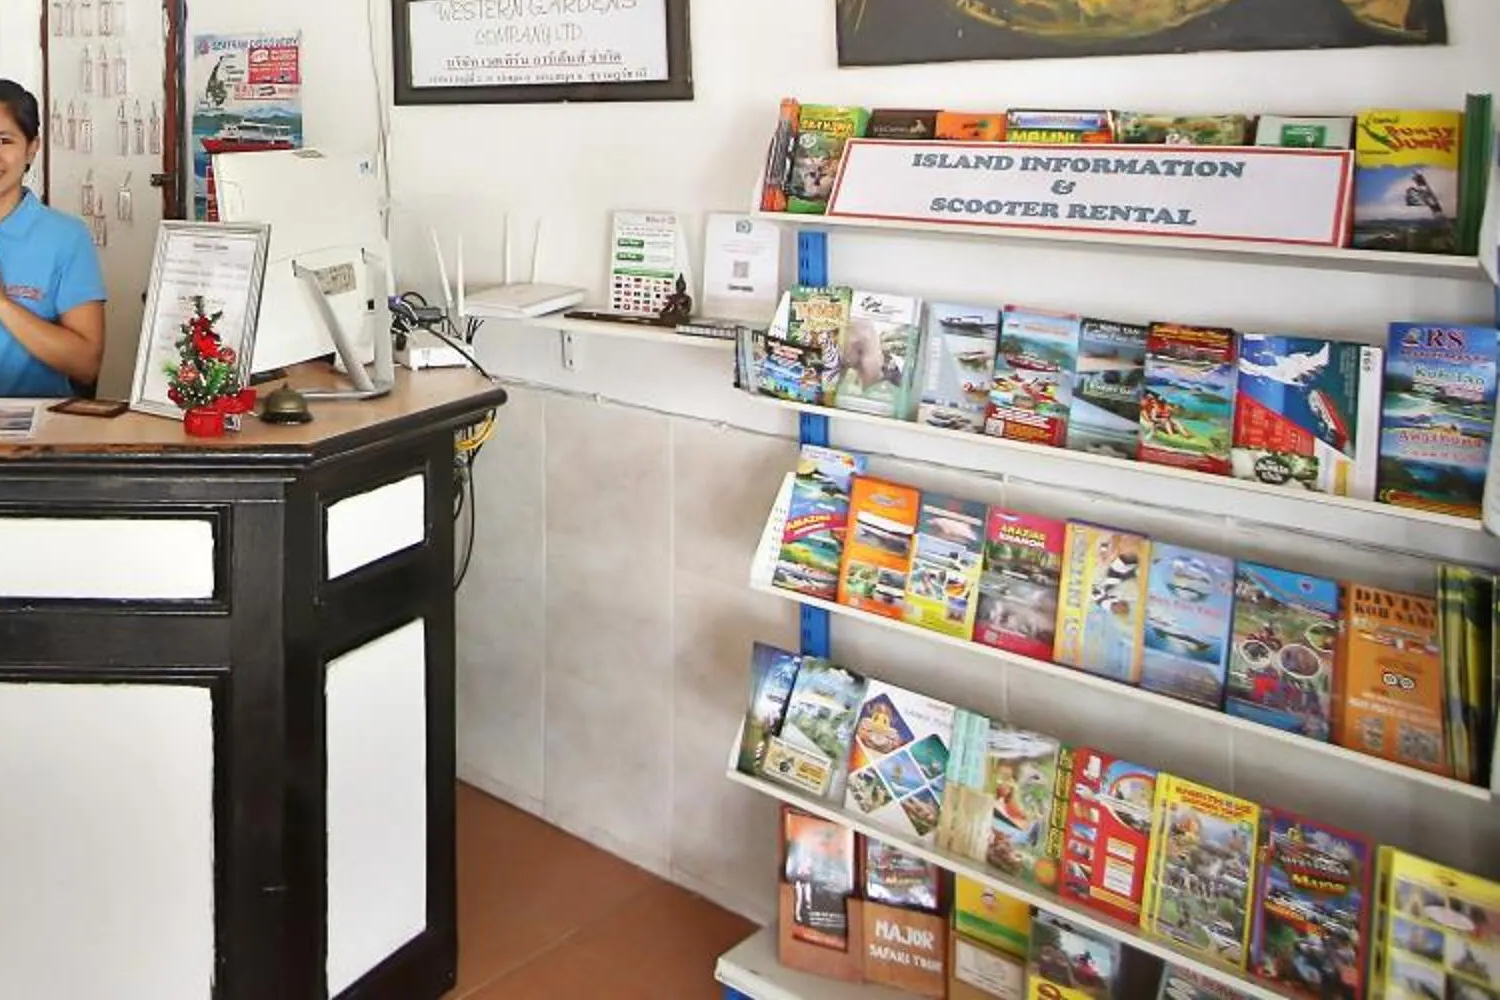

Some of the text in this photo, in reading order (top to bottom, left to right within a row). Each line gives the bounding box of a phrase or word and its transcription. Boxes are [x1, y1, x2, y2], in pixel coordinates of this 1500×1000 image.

[912, 153, 1247, 179] ISLAND INFORMATION
[1051, 178, 1077, 196] &
[930, 197, 1196, 226] SCOOTER RENTAL
